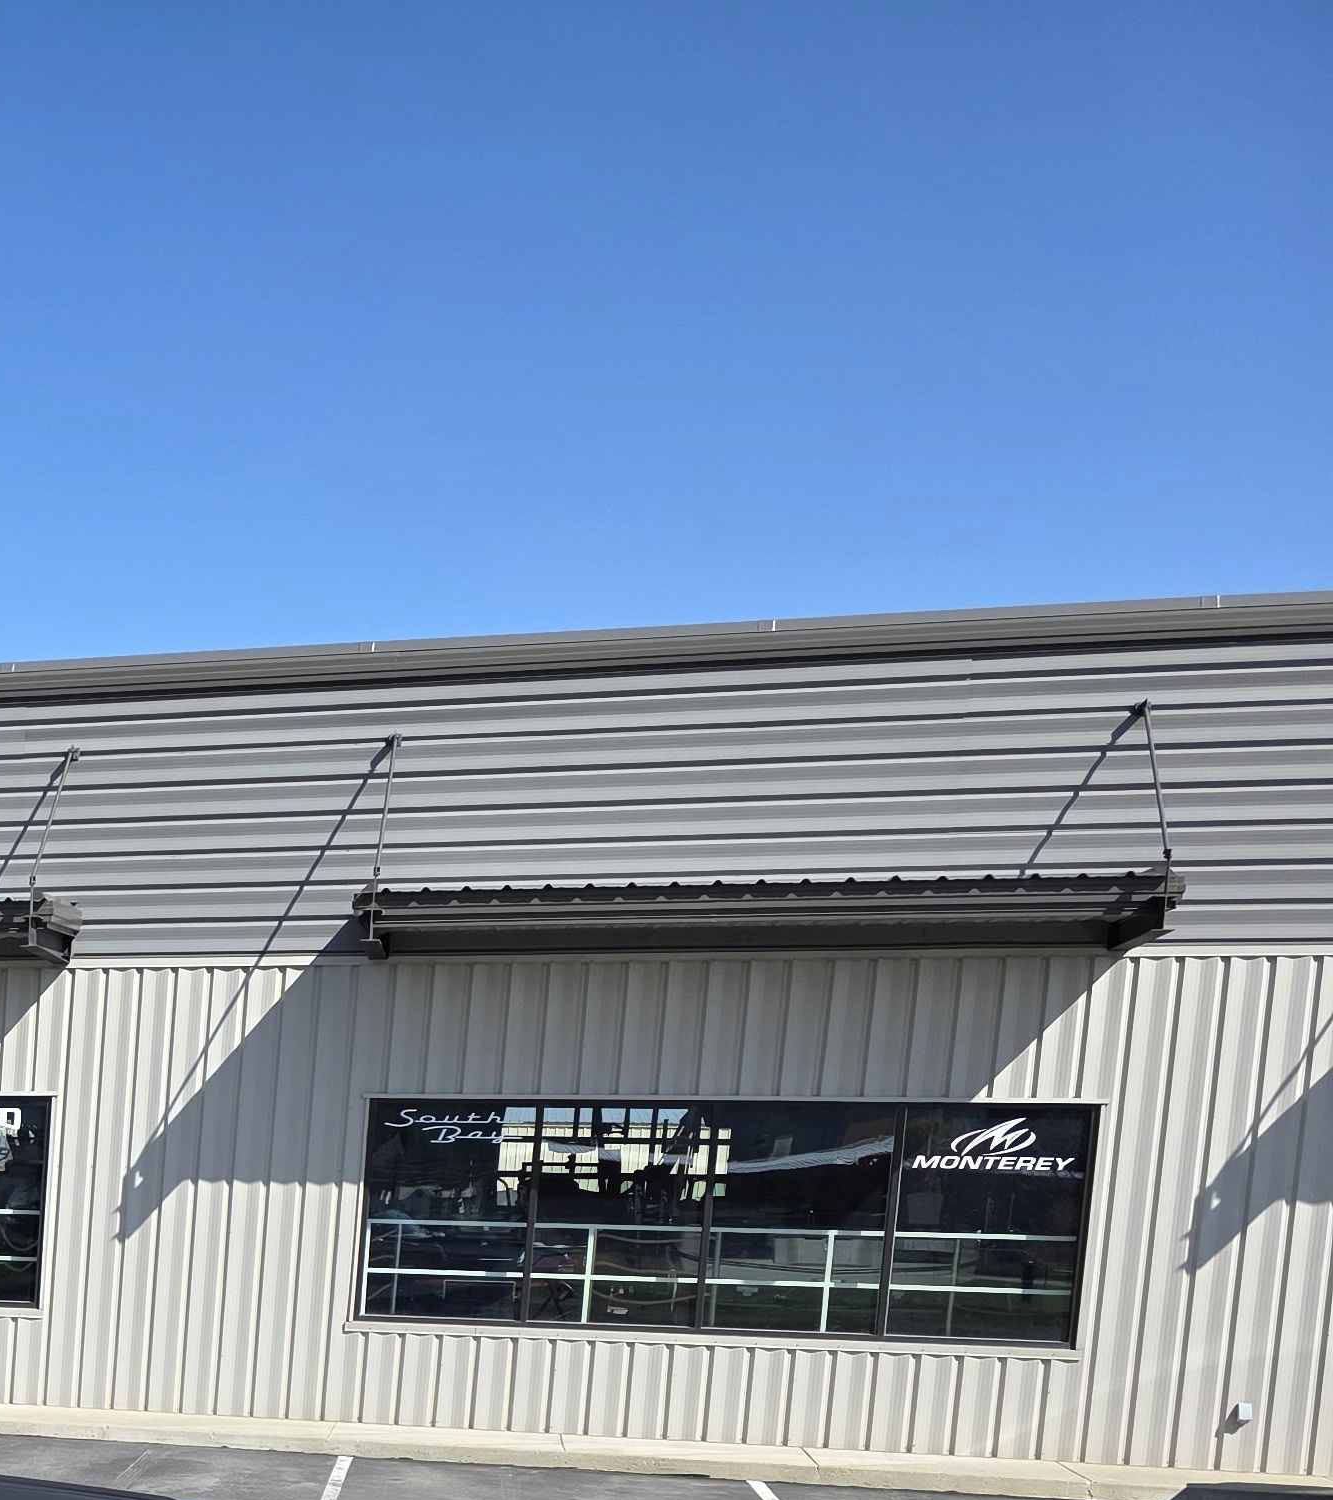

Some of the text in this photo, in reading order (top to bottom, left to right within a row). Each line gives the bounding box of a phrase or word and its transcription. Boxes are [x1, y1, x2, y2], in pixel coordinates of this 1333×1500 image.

[384, 1109, 507, 1127] South
[422, 1126, 521, 1143] Bay
[912, 1155, 1075, 1171] MONTEREY
